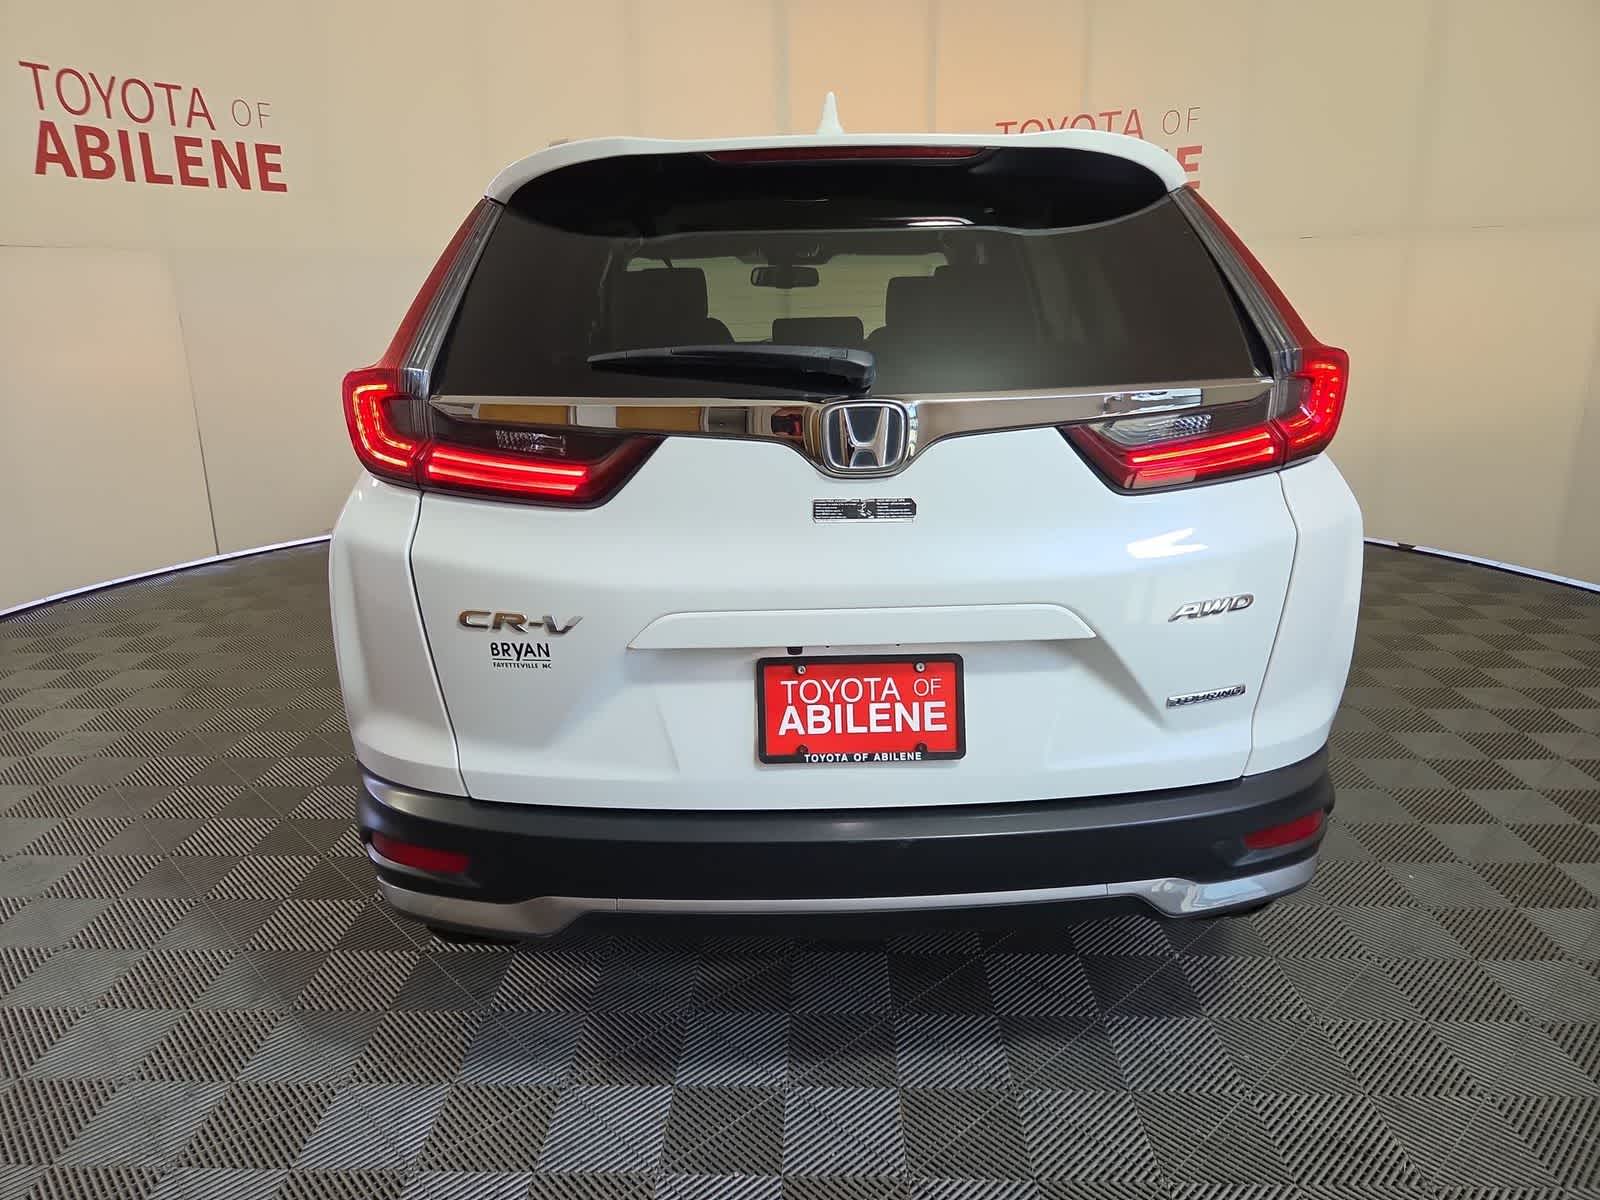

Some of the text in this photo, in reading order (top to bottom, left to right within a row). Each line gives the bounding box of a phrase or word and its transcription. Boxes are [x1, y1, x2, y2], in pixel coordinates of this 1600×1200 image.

[19, 60, 272, 131] TOYOTA OF
[1162, 106, 1200, 136] OF
[34, 120, 288, 193] ABILENE
[1168, 593, 1255, 623] AWD
[458, 610, 584, 636] CR-V
[490, 641, 551, 661] BRYAN
[492, 661, 538, 669] FAYETTEVILLE
[781, 677, 942, 704] TOYOTA OF
[778, 701, 948, 736] ABILENE
[804, 751, 922, 762] TOYOTA OF ABILENE
